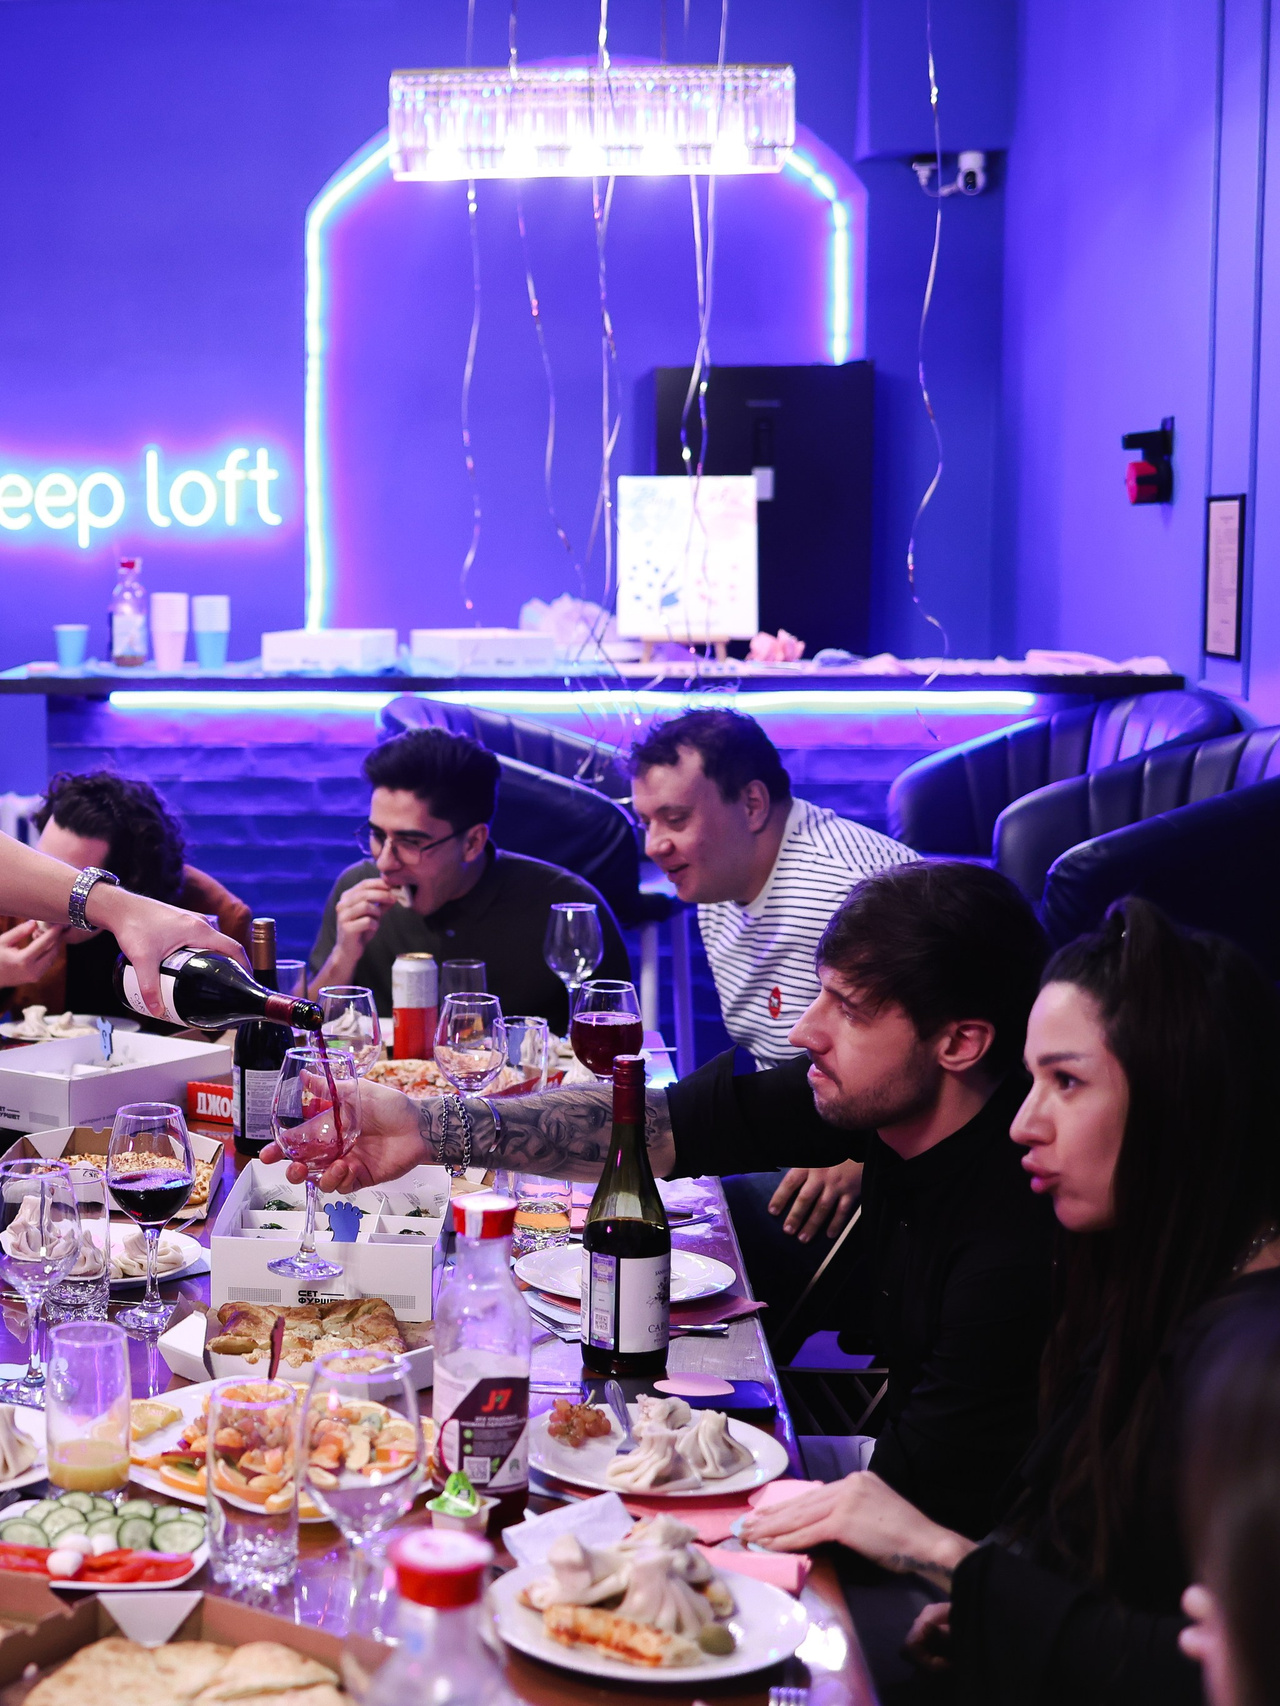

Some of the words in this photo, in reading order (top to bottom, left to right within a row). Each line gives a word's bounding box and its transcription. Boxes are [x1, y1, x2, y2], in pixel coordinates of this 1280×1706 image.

[145, 447, 283, 528] loft
[196, 1092, 234, 1118] ДЖО
[298, 1297, 339, 1305] ФУРШ
[481, 1388, 513, 1413] J7
